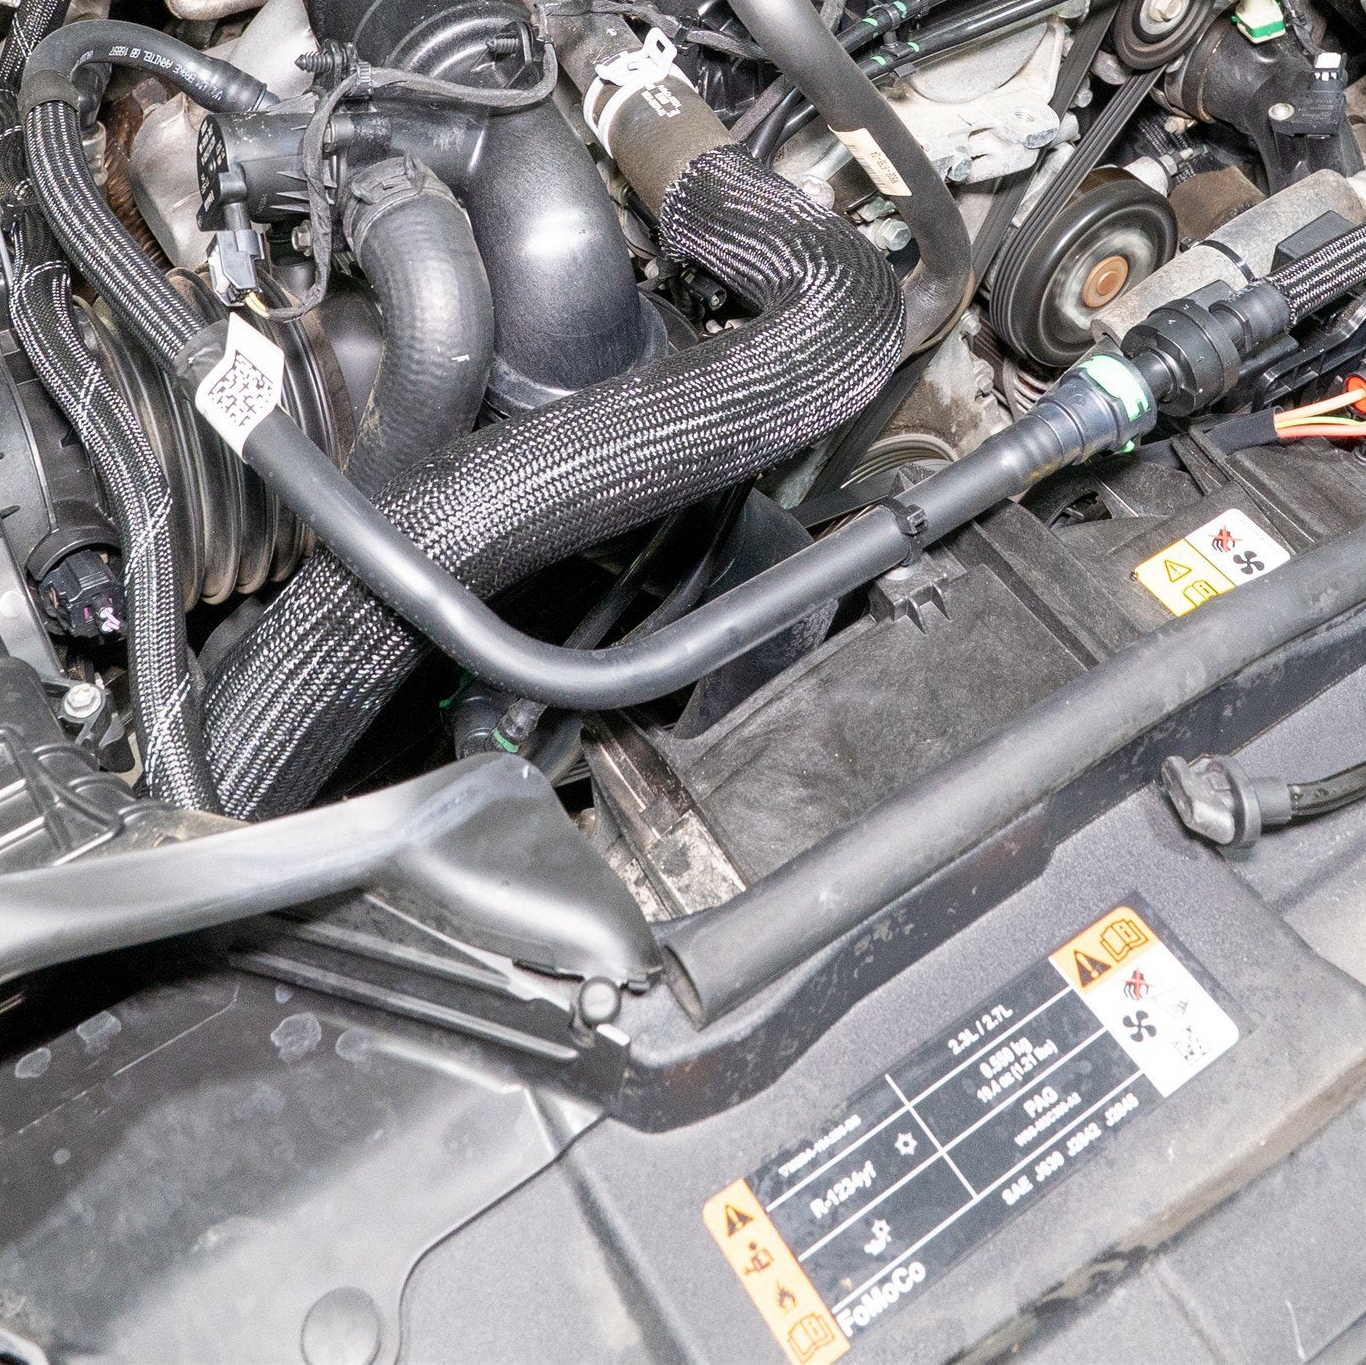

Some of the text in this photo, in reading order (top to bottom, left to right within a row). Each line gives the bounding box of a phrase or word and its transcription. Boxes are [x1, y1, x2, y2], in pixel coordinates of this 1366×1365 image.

[981, 1004, 1013, 1031] 2.7L
[1023, 1085, 1059, 1119] PAG
[809, 1159, 877, 1219] R-1234yf
[1001, 1175, 1034, 1205] SAE
[836, 1261, 927, 1337] FoMoCo
